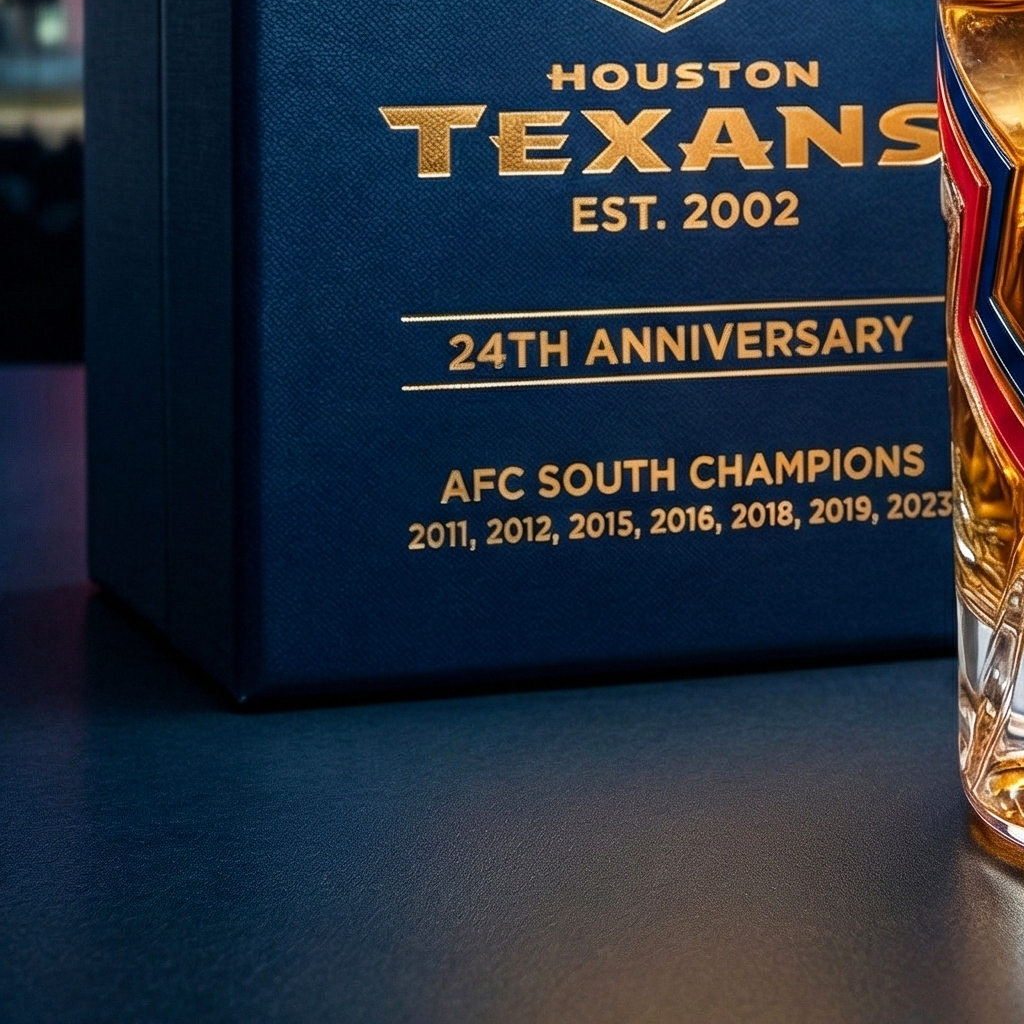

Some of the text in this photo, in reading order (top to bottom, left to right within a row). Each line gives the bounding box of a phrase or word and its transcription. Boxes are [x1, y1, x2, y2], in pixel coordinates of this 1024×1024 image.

[546, 60, 820, 91] HOUSTON
[378, 102, 942, 178] TEXANS
[571, 190, 801, 234] EST. 2002
[447, 314, 914, 372] 24TH ANNIVERSARY
[440, 443, 926, 505] AFC SOUTH CHAMPIONS
[407, 490, 954, 552] 2011, 2012, 2015, 2016, 2018, 2019, 2023
